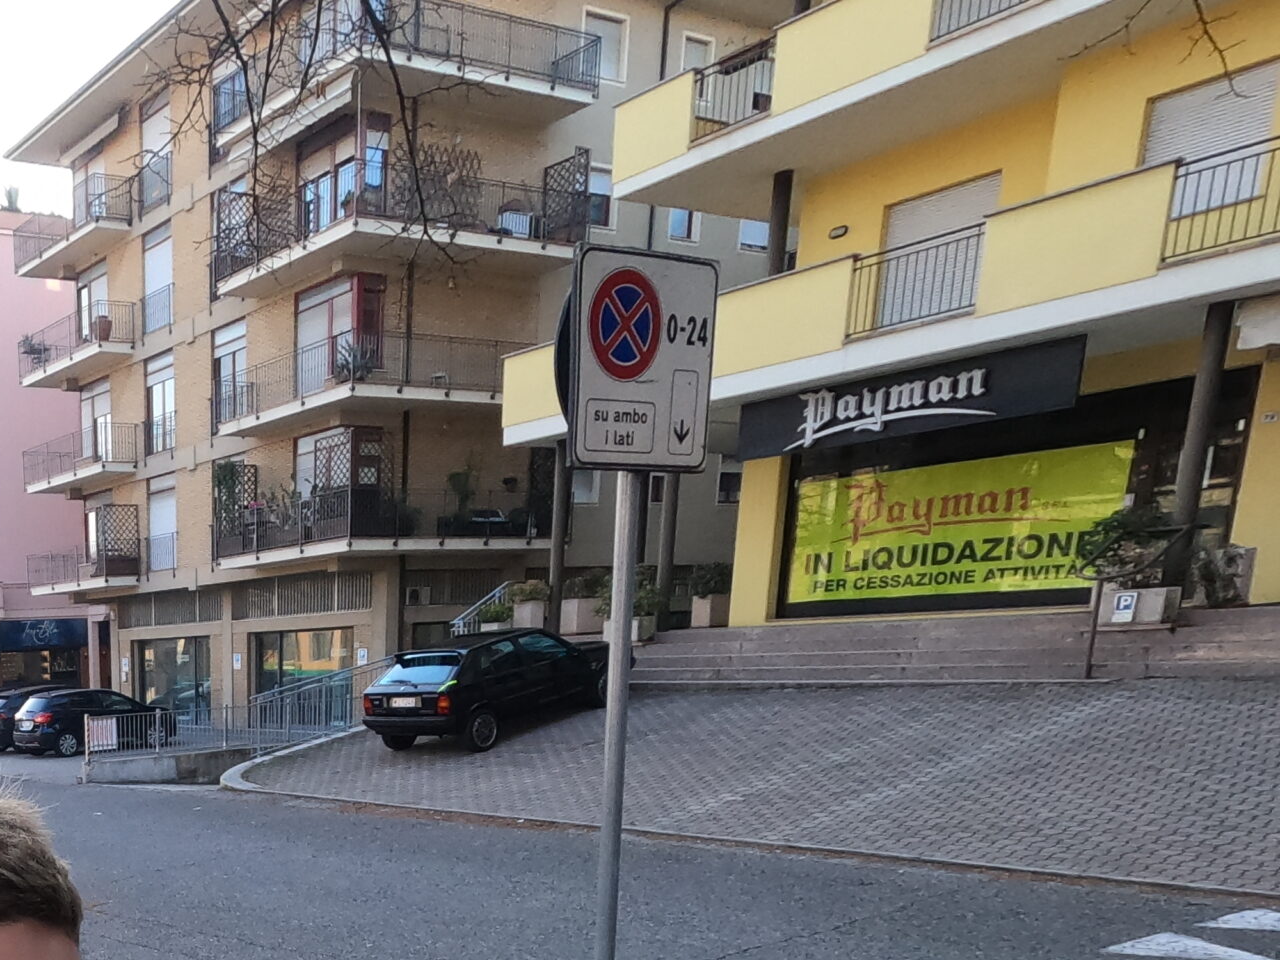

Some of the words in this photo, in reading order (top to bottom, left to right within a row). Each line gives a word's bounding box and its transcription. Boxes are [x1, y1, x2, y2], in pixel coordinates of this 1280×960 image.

[666, 313, 709, 347] 0-24
[593, 408, 609, 421] su
[613, 406, 648, 424] ambo
[796, 367, 987, 448] Payman
[604, 431, 609, 445] i
[613, 431, 634, 446] lati
[841, 479, 1033, 546] Payman
[804, 550, 833, 576] IN
[813, 577, 847, 593] PER
[853, 569, 977, 592] CESSAZIONE
